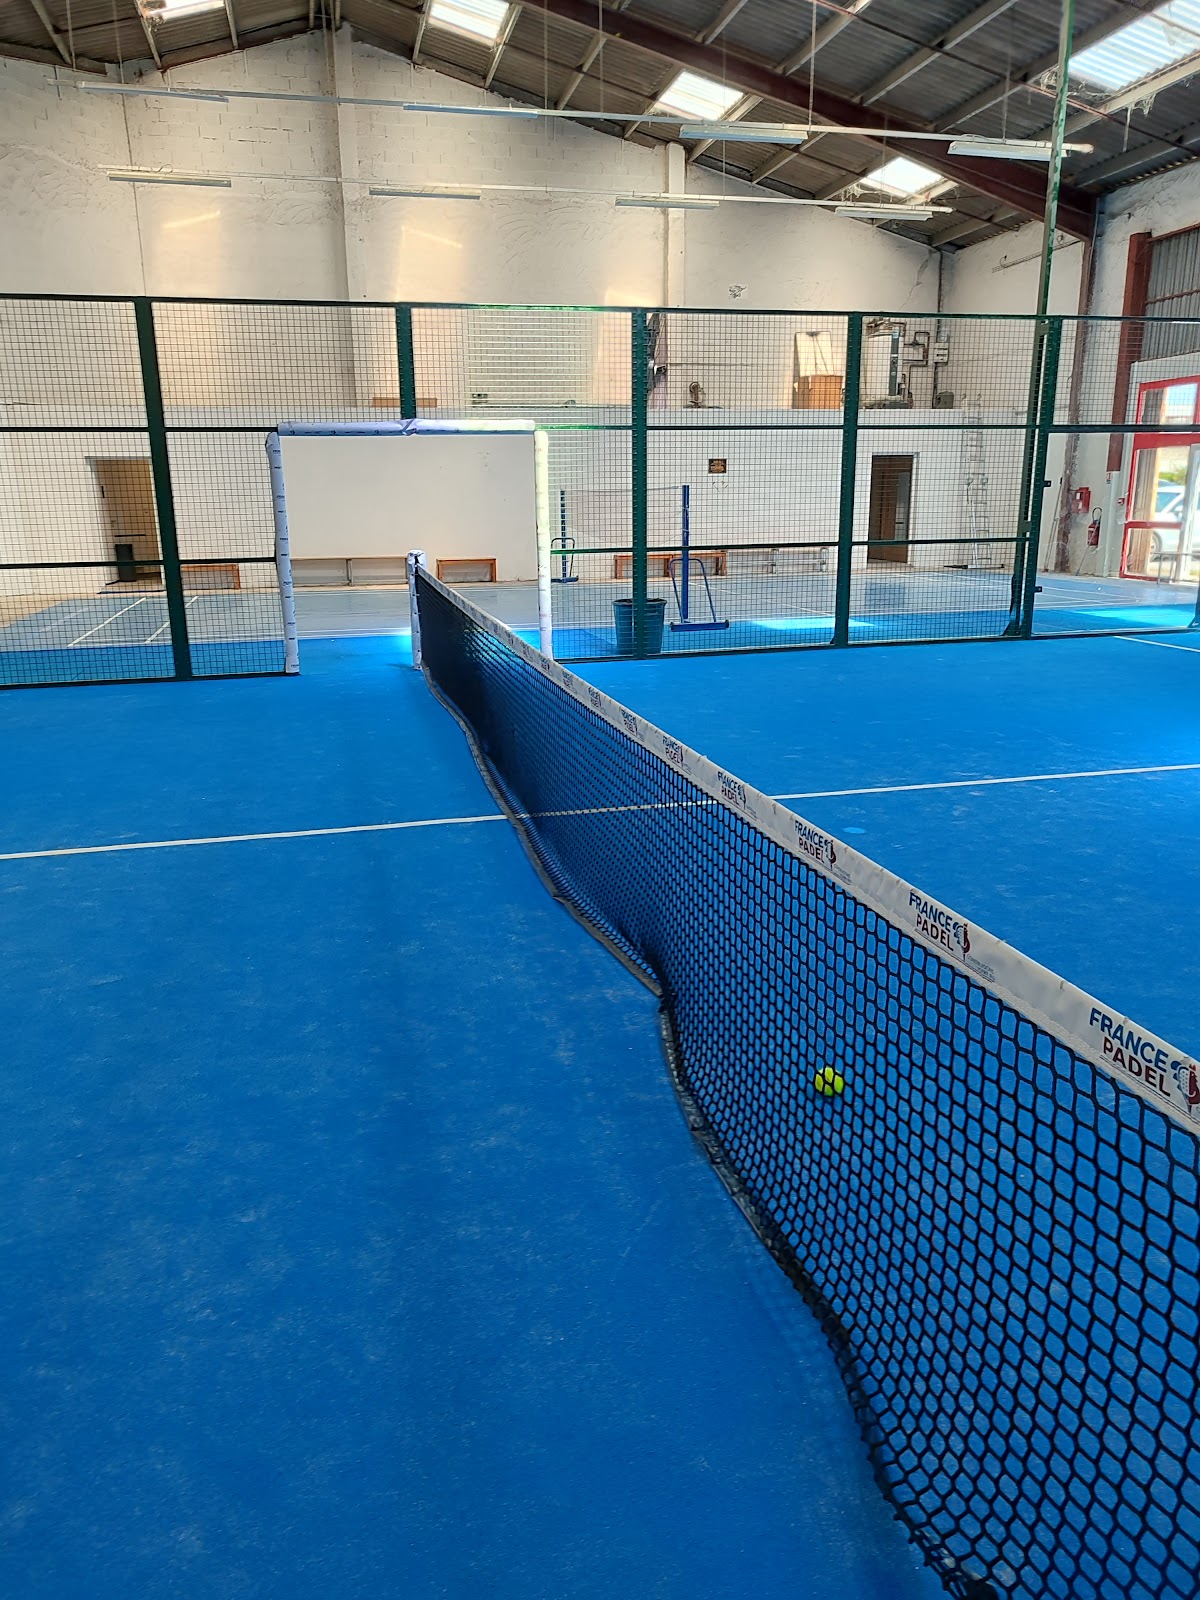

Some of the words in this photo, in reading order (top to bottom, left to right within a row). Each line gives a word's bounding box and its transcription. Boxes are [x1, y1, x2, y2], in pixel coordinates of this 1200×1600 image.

[794, 820, 824, 849] FRANCE
[798, 837, 825, 863] PADEL
[909, 891, 953, 933] FRANCE
[916, 913, 954, 951] PADEL
[1089, 1007, 1169, 1073] FRANCE
[1103, 1036, 1171, 1097] PADEL
